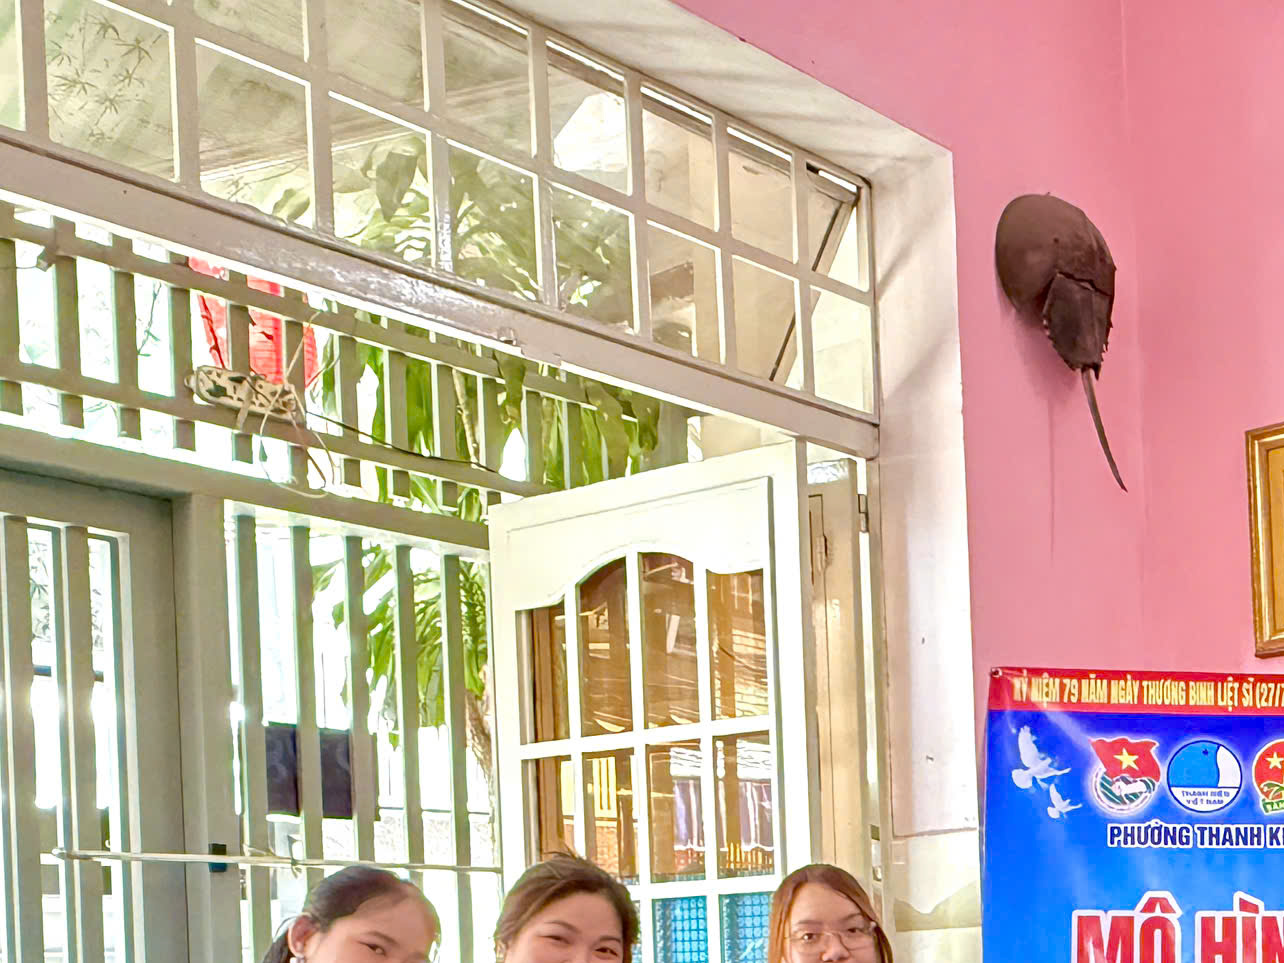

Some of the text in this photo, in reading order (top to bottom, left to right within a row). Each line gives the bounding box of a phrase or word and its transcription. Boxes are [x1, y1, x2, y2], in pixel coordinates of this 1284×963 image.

[1031, 672, 1060, 708] NIỆM
[1063, 678, 1079, 703] 79
[1081, 673, 1108, 704] NĂM
[1110, 674, 1140, 705] NGÀY
[1189, 680, 1215, 706] BINH
[1217, 676, 1239, 712] LIỆT
[1109, 820, 1191, 847] PHƯỜNG
[1197, 825, 1262, 847] THANH
